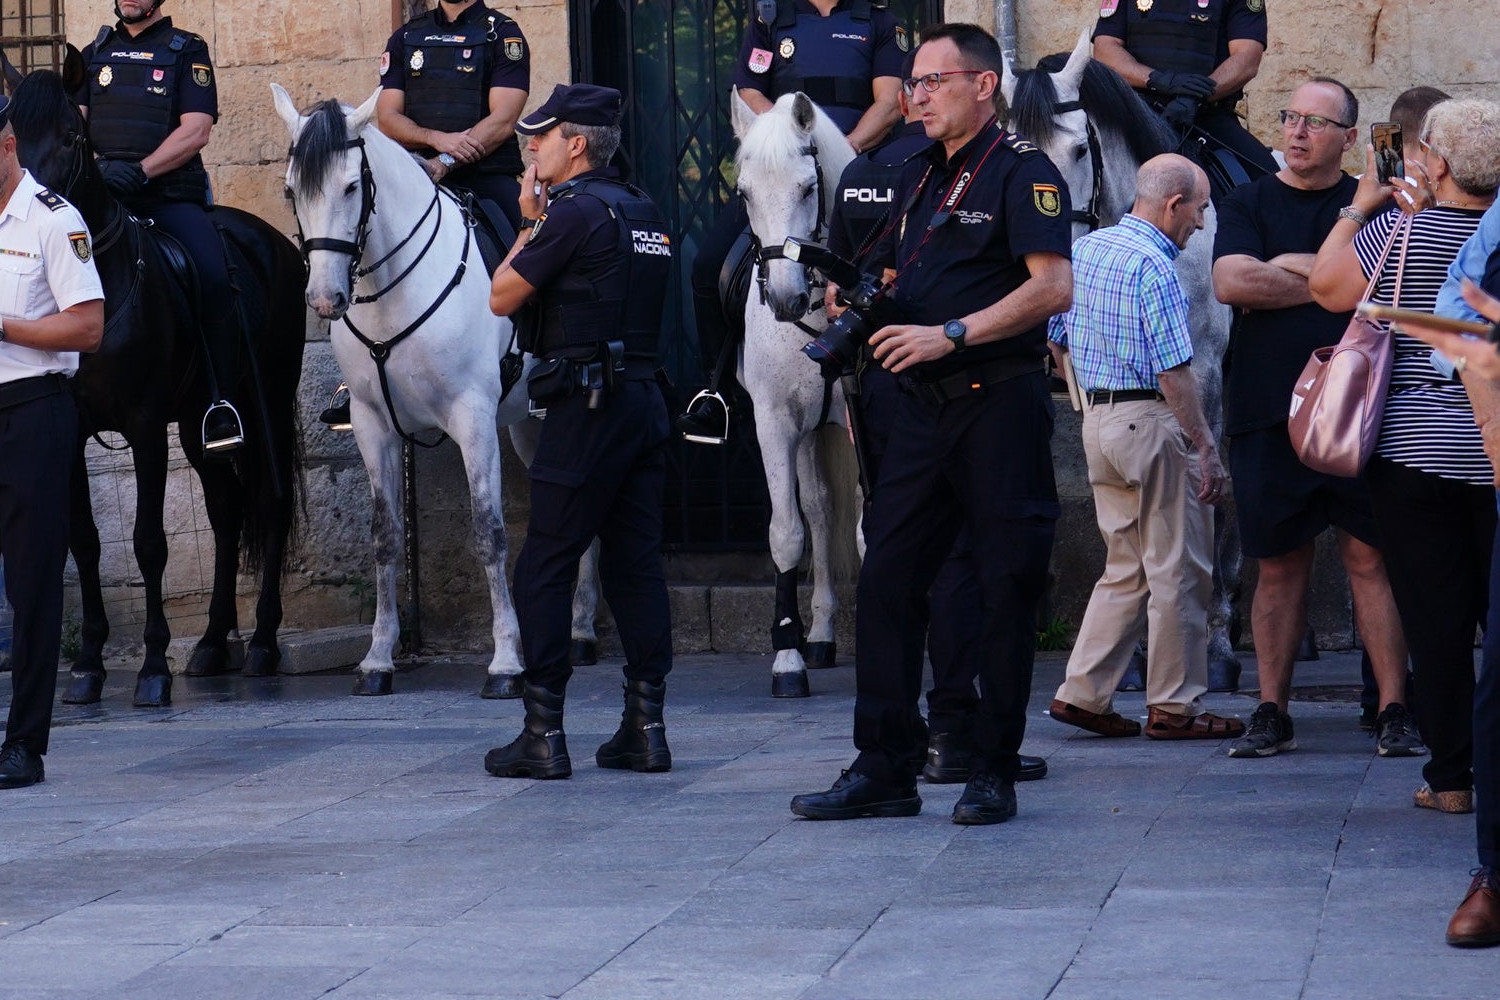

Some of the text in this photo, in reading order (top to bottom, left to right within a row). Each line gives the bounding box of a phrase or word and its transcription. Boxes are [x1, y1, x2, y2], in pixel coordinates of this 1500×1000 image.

[843, 188, 894, 203] POLI
[946, 172, 971, 206] Canon
[953, 210, 989, 219] POLICIA
[633, 242, 671, 257] NACIONAL
